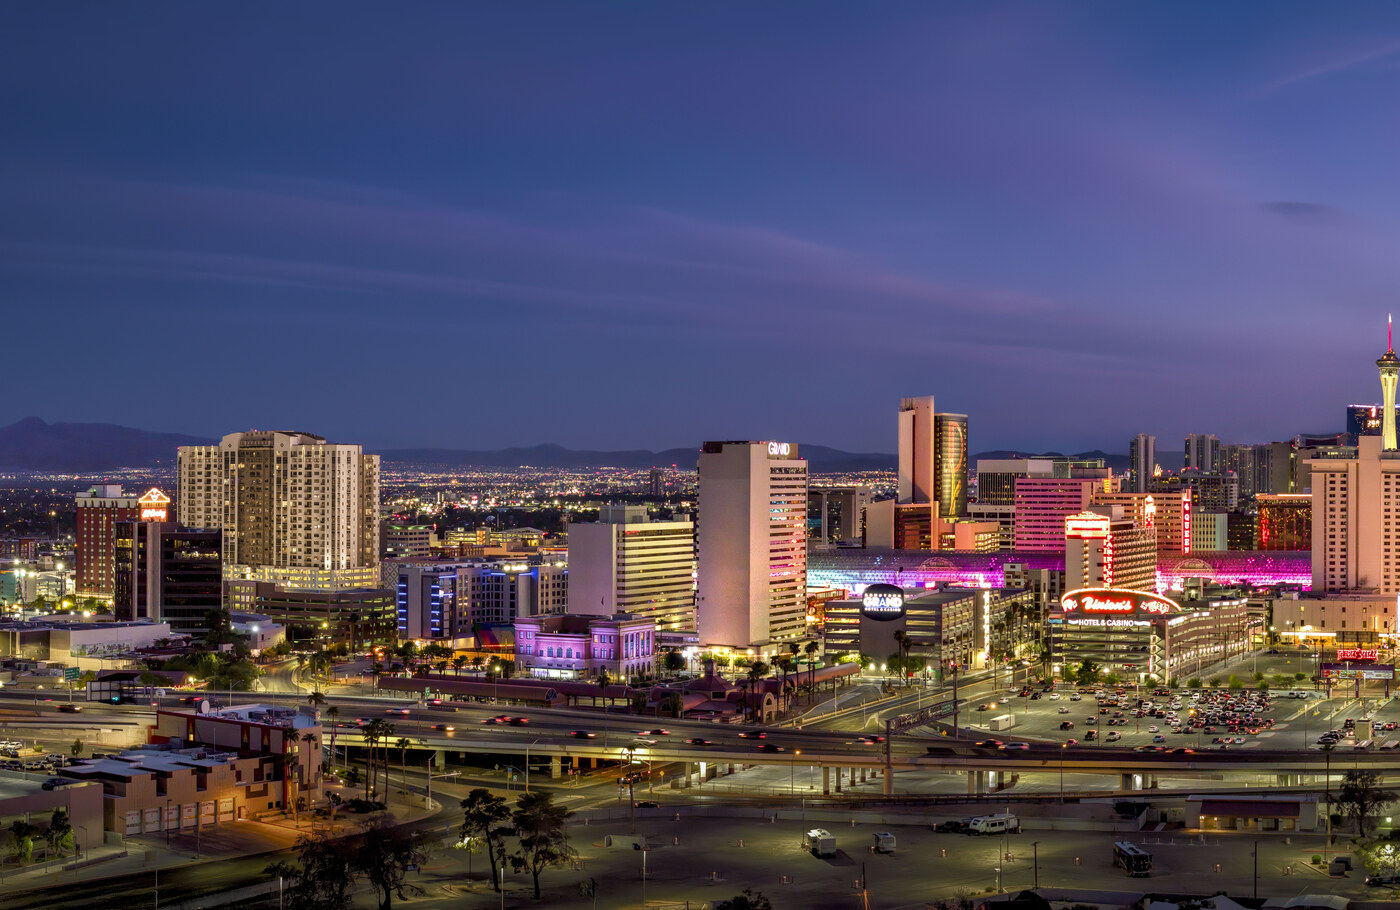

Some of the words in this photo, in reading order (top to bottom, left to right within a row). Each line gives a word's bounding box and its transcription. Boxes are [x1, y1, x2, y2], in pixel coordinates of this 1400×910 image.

[768, 441, 790, 456] GRAND
[863, 597, 902, 607] GRAND
[1081, 597, 1132, 610] Binion's
[1106, 619, 1134, 627] CASINO
